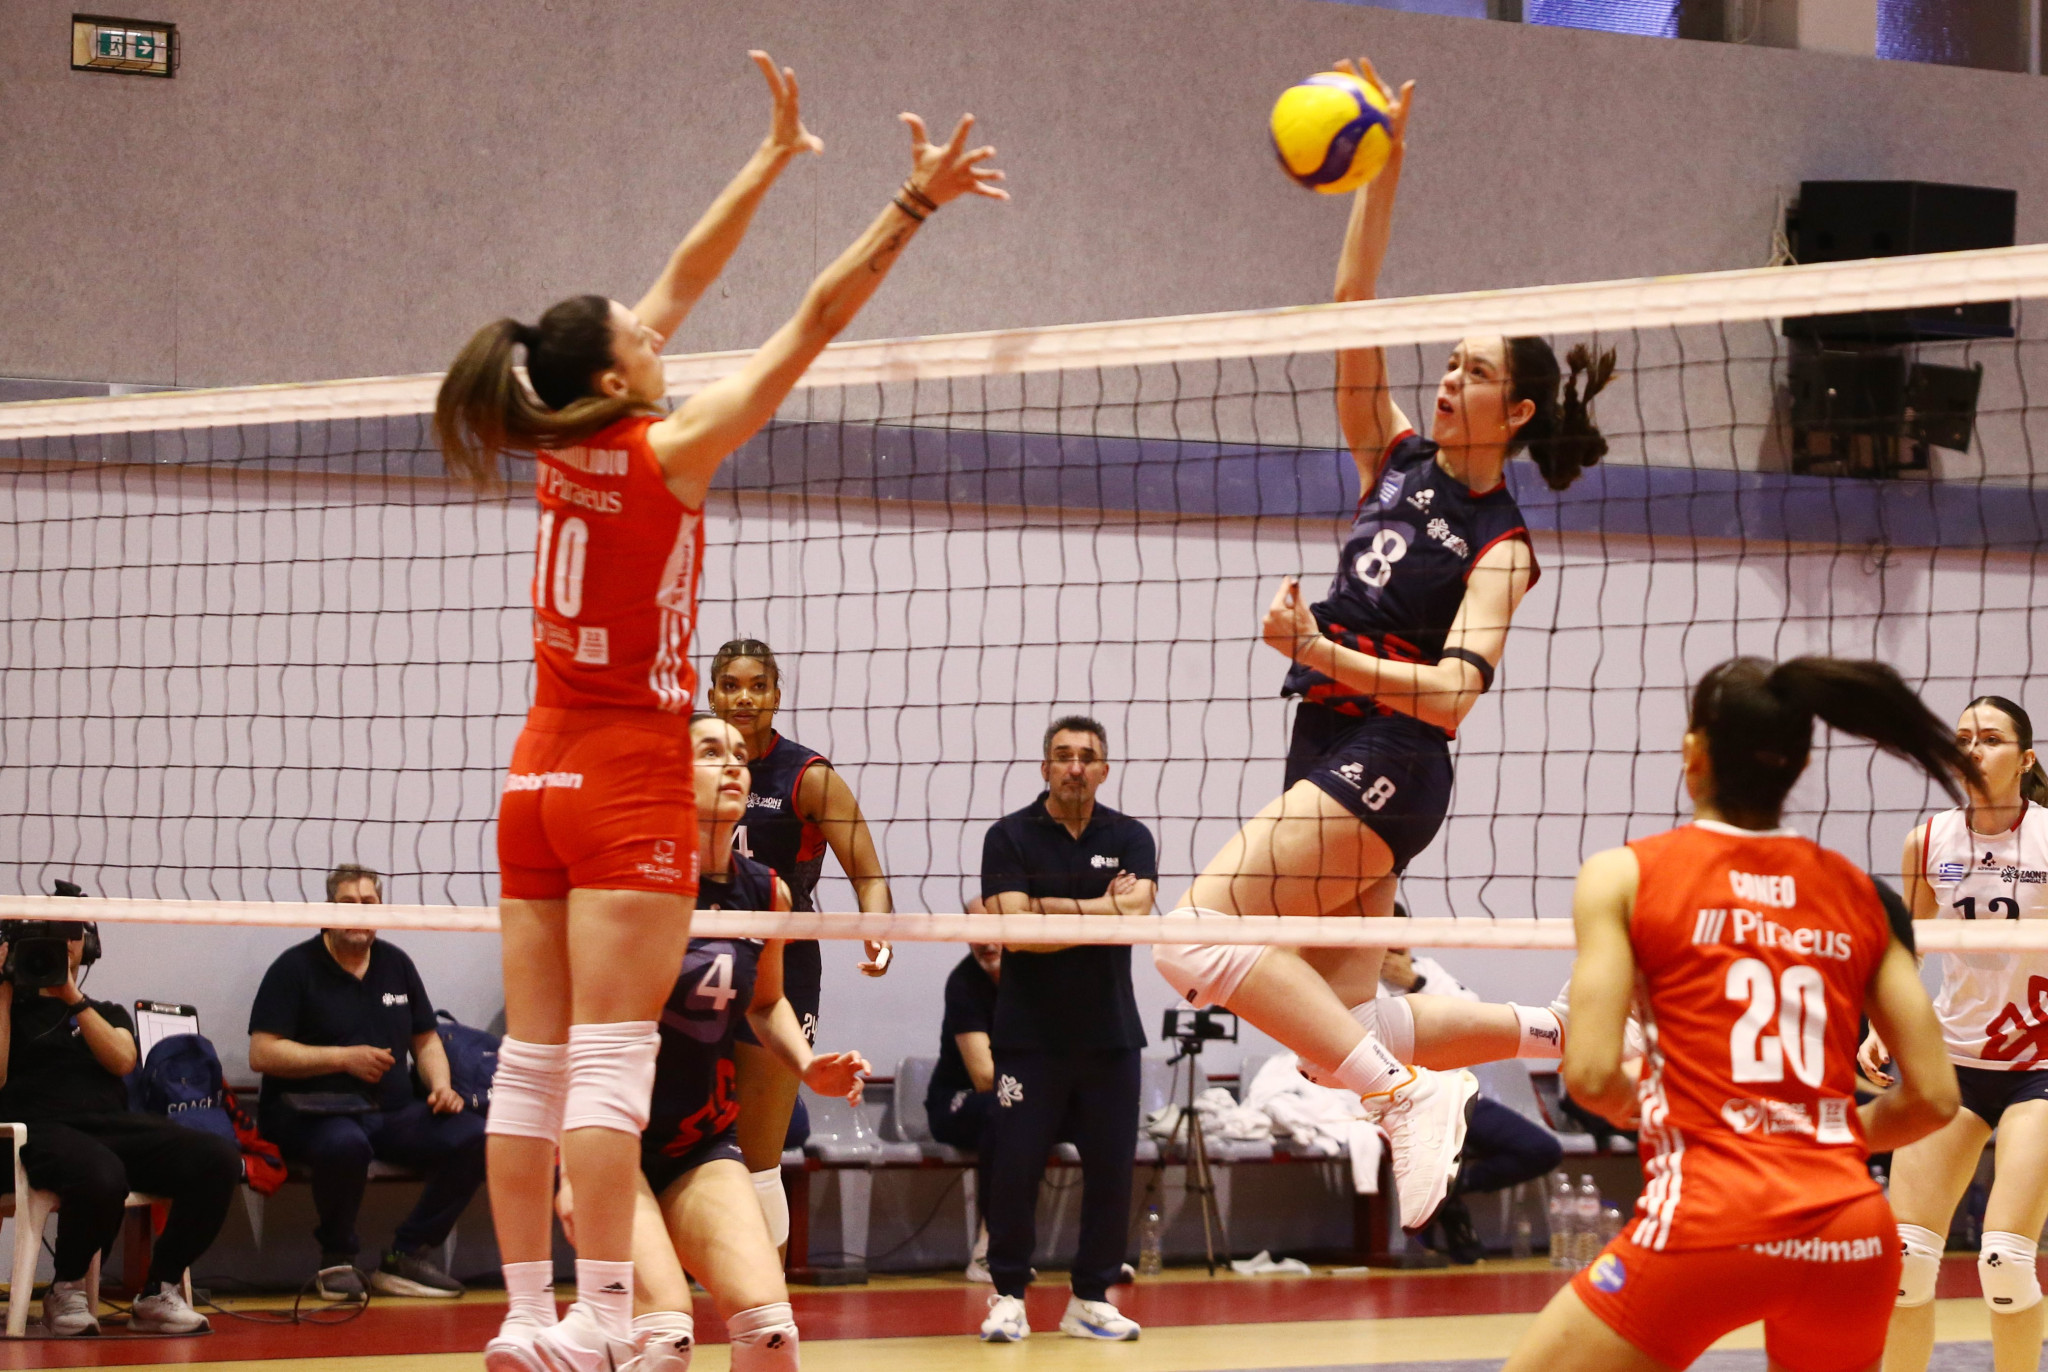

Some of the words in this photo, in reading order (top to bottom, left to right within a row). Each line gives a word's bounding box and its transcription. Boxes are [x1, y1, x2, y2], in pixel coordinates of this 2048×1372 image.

[537, 509, 589, 618] 10
[1356, 529, 1407, 587] 8
[1361, 775, 1396, 811] 8
[1732, 908, 1852, 961] Piraeus
[696, 953, 737, 1010] 4
[1725, 957, 1828, 1089] 20
[1739, 1236, 1883, 1262] oiximan
